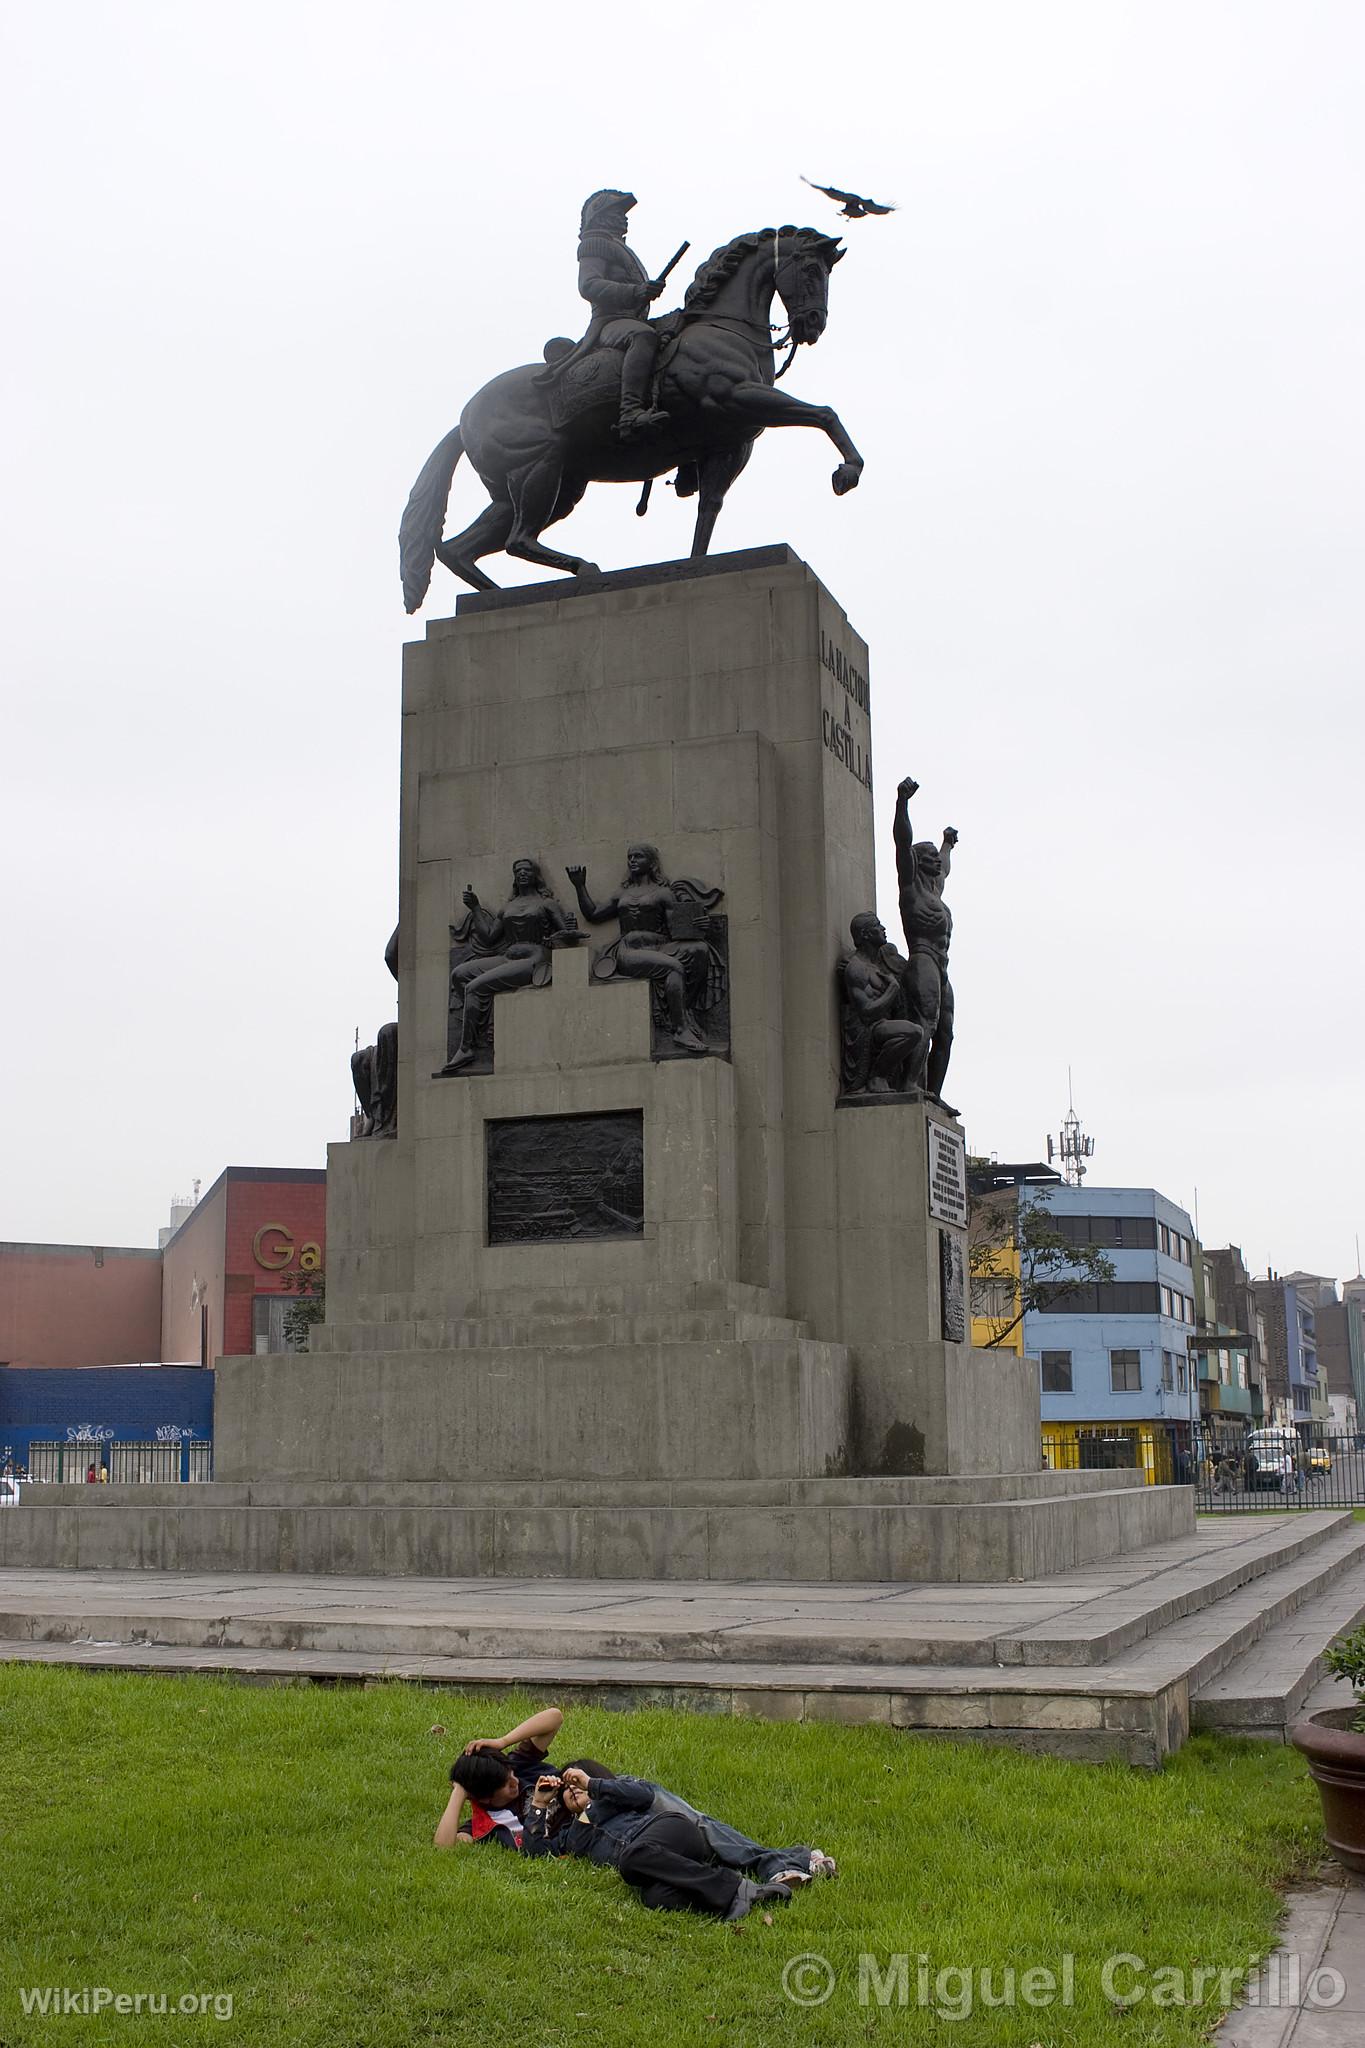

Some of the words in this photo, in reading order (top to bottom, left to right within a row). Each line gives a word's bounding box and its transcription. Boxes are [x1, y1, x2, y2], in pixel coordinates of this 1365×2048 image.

[844, 694, 851, 730] A
[823, 709, 872, 792] CASTILLA
[253, 1222, 321, 1271] Ga
